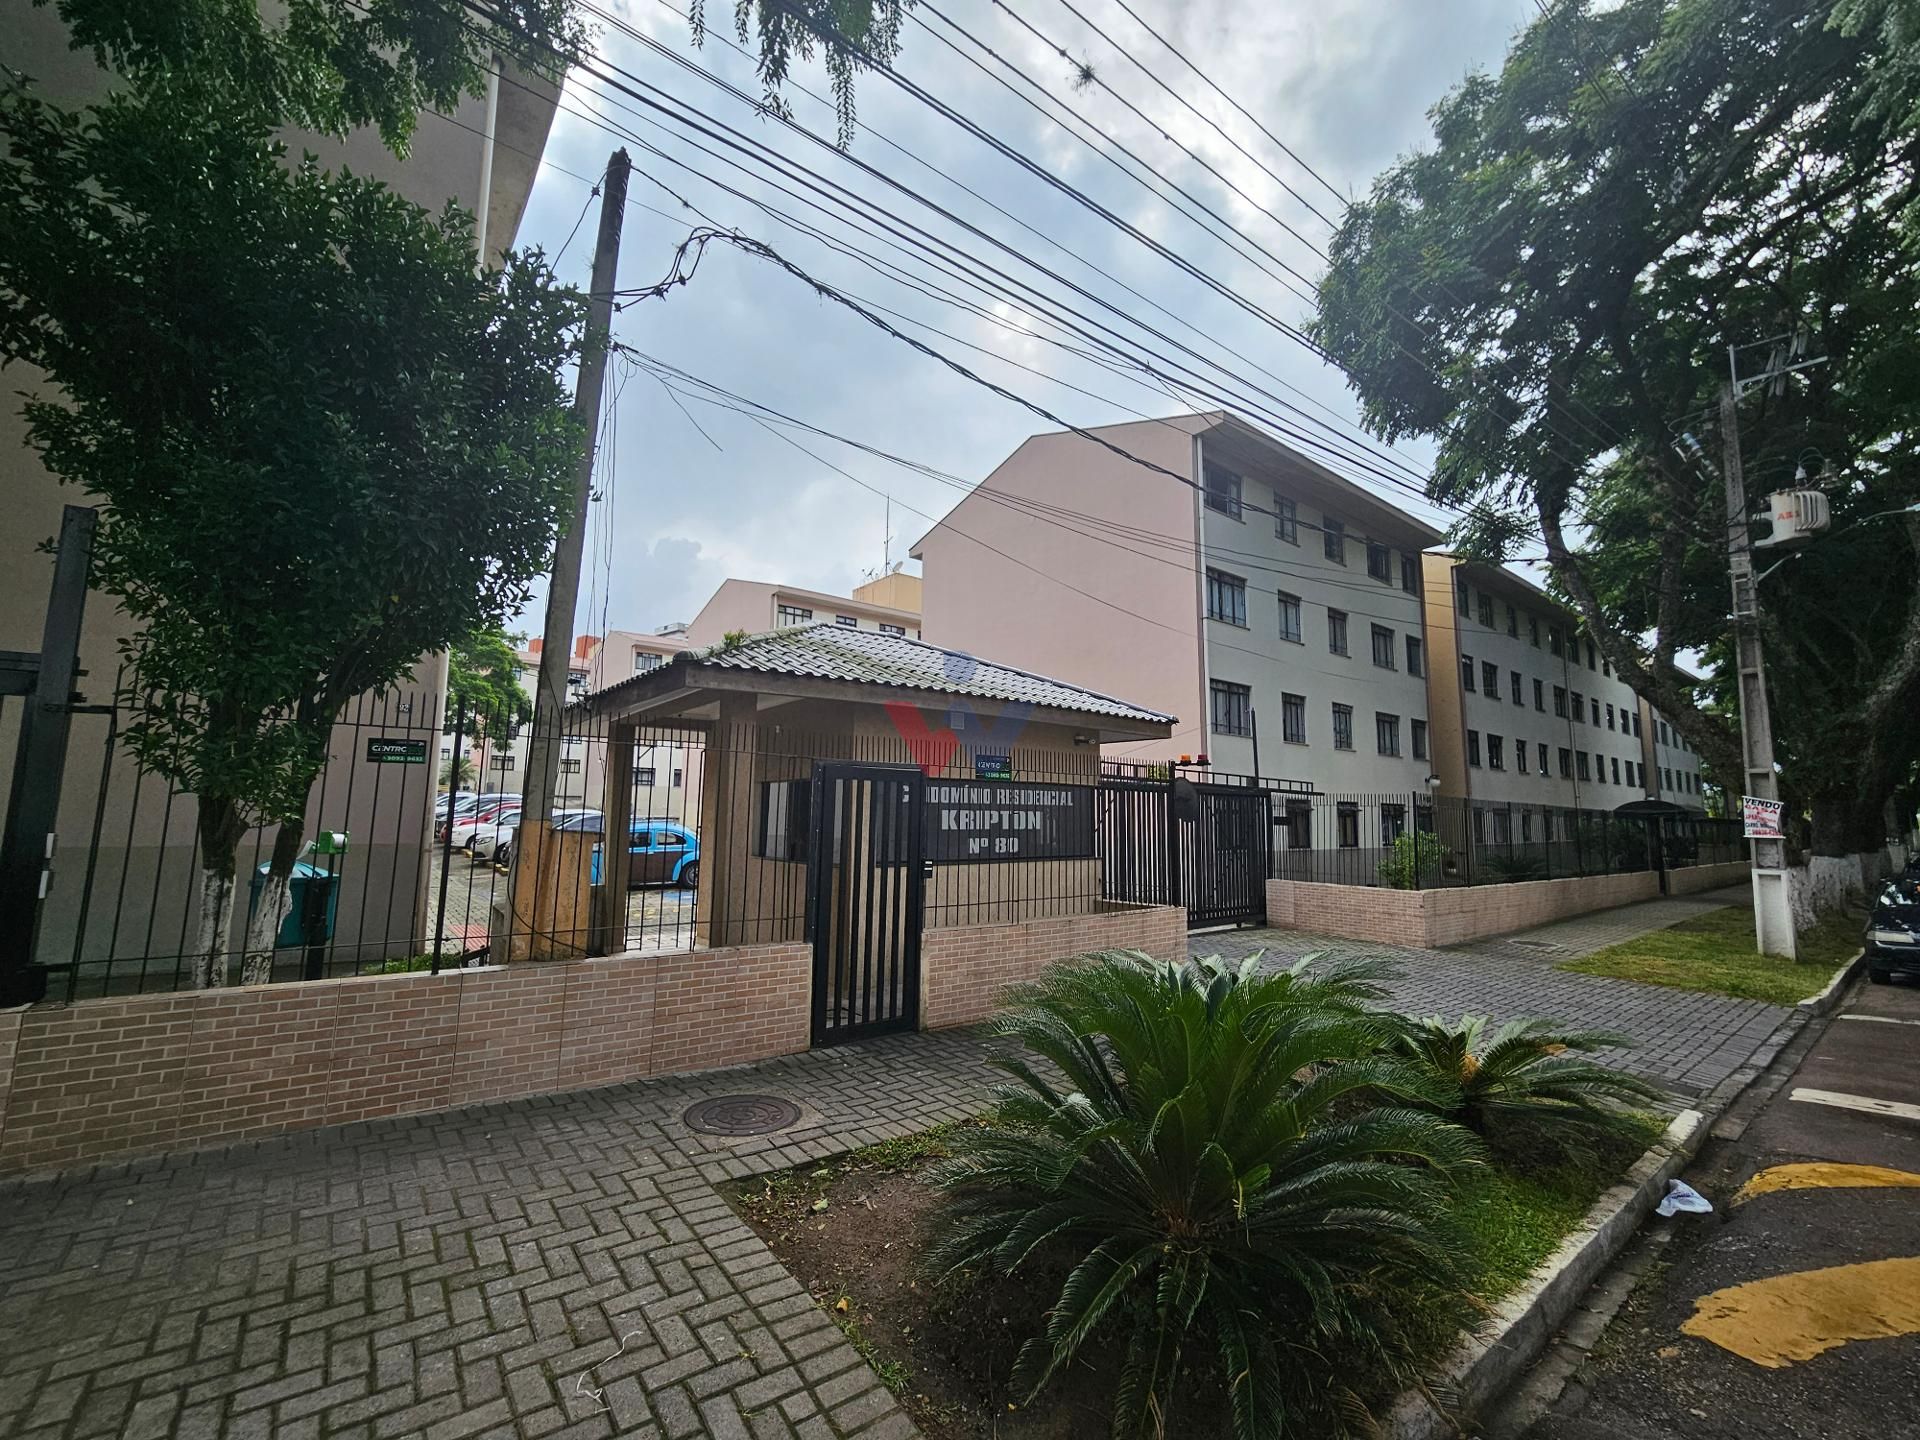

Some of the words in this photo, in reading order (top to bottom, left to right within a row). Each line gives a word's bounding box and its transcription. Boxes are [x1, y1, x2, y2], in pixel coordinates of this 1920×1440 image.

[902, 784, 993, 804] CDOMÍNIO
[1745, 798, 1780, 810] VENDO
[941, 809, 1041, 831] KRIPTON
[994, 837, 1019, 853] 80
